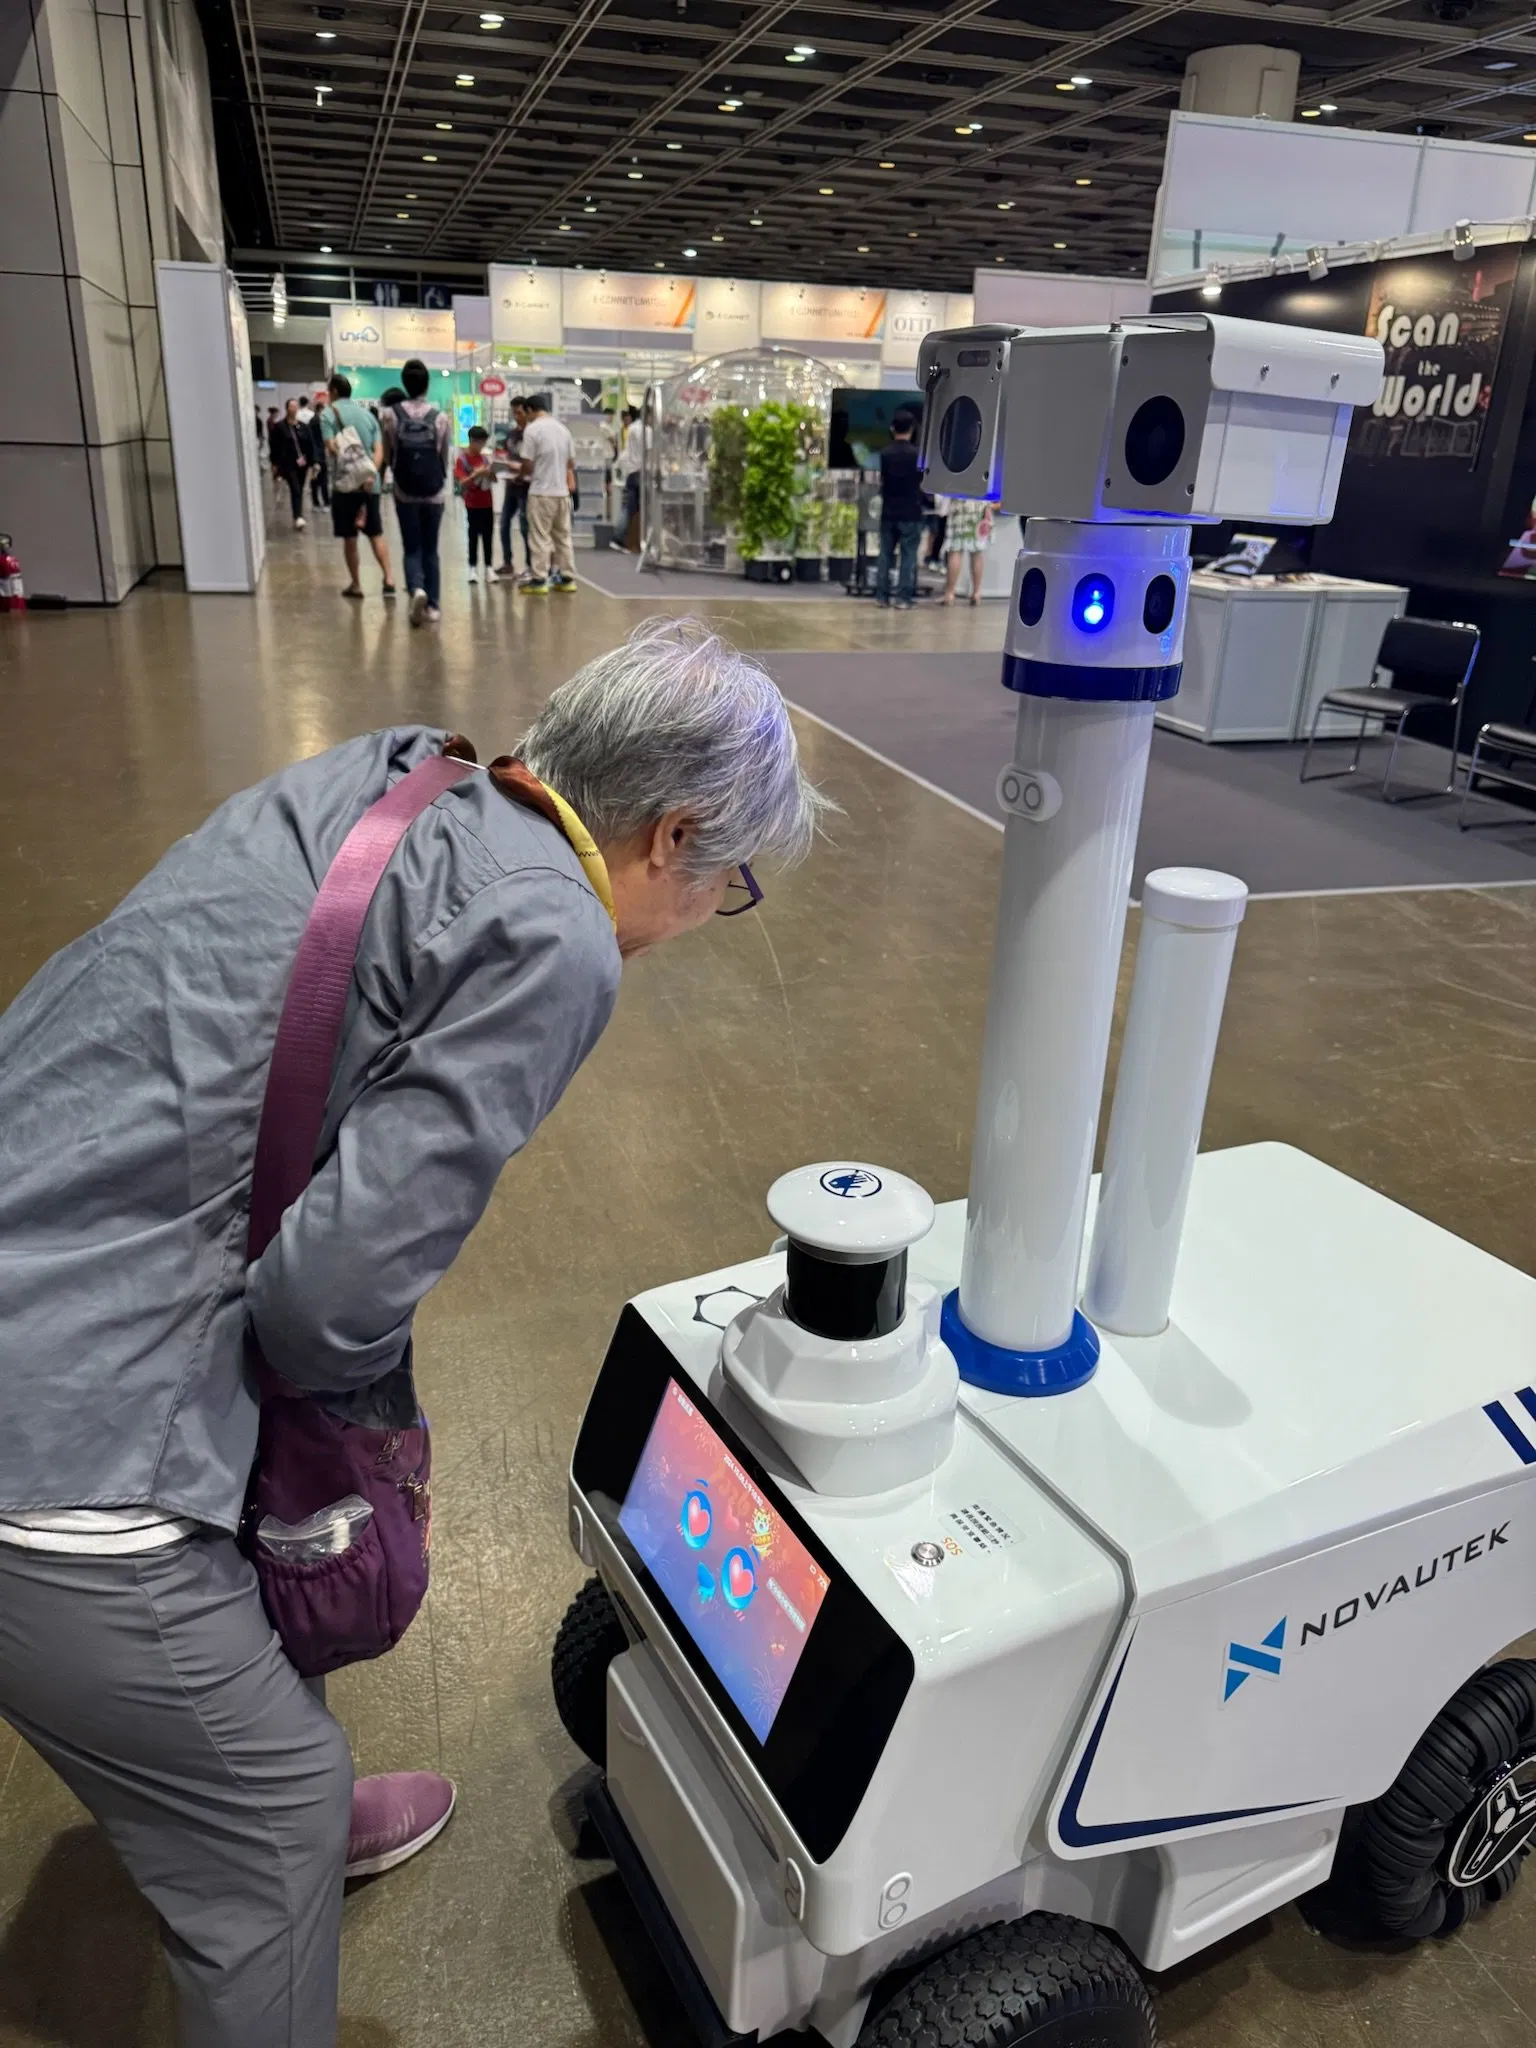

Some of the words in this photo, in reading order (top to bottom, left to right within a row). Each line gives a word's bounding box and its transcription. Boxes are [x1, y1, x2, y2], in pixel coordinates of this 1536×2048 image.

[1375, 304, 1460, 348] Scan
[1418, 360, 1441, 377] the
[1372, 372, 1483, 418] World
[944, 1536, 963, 1556] SOS
[1300, 1521, 1511, 1646] NOVAUTEK
